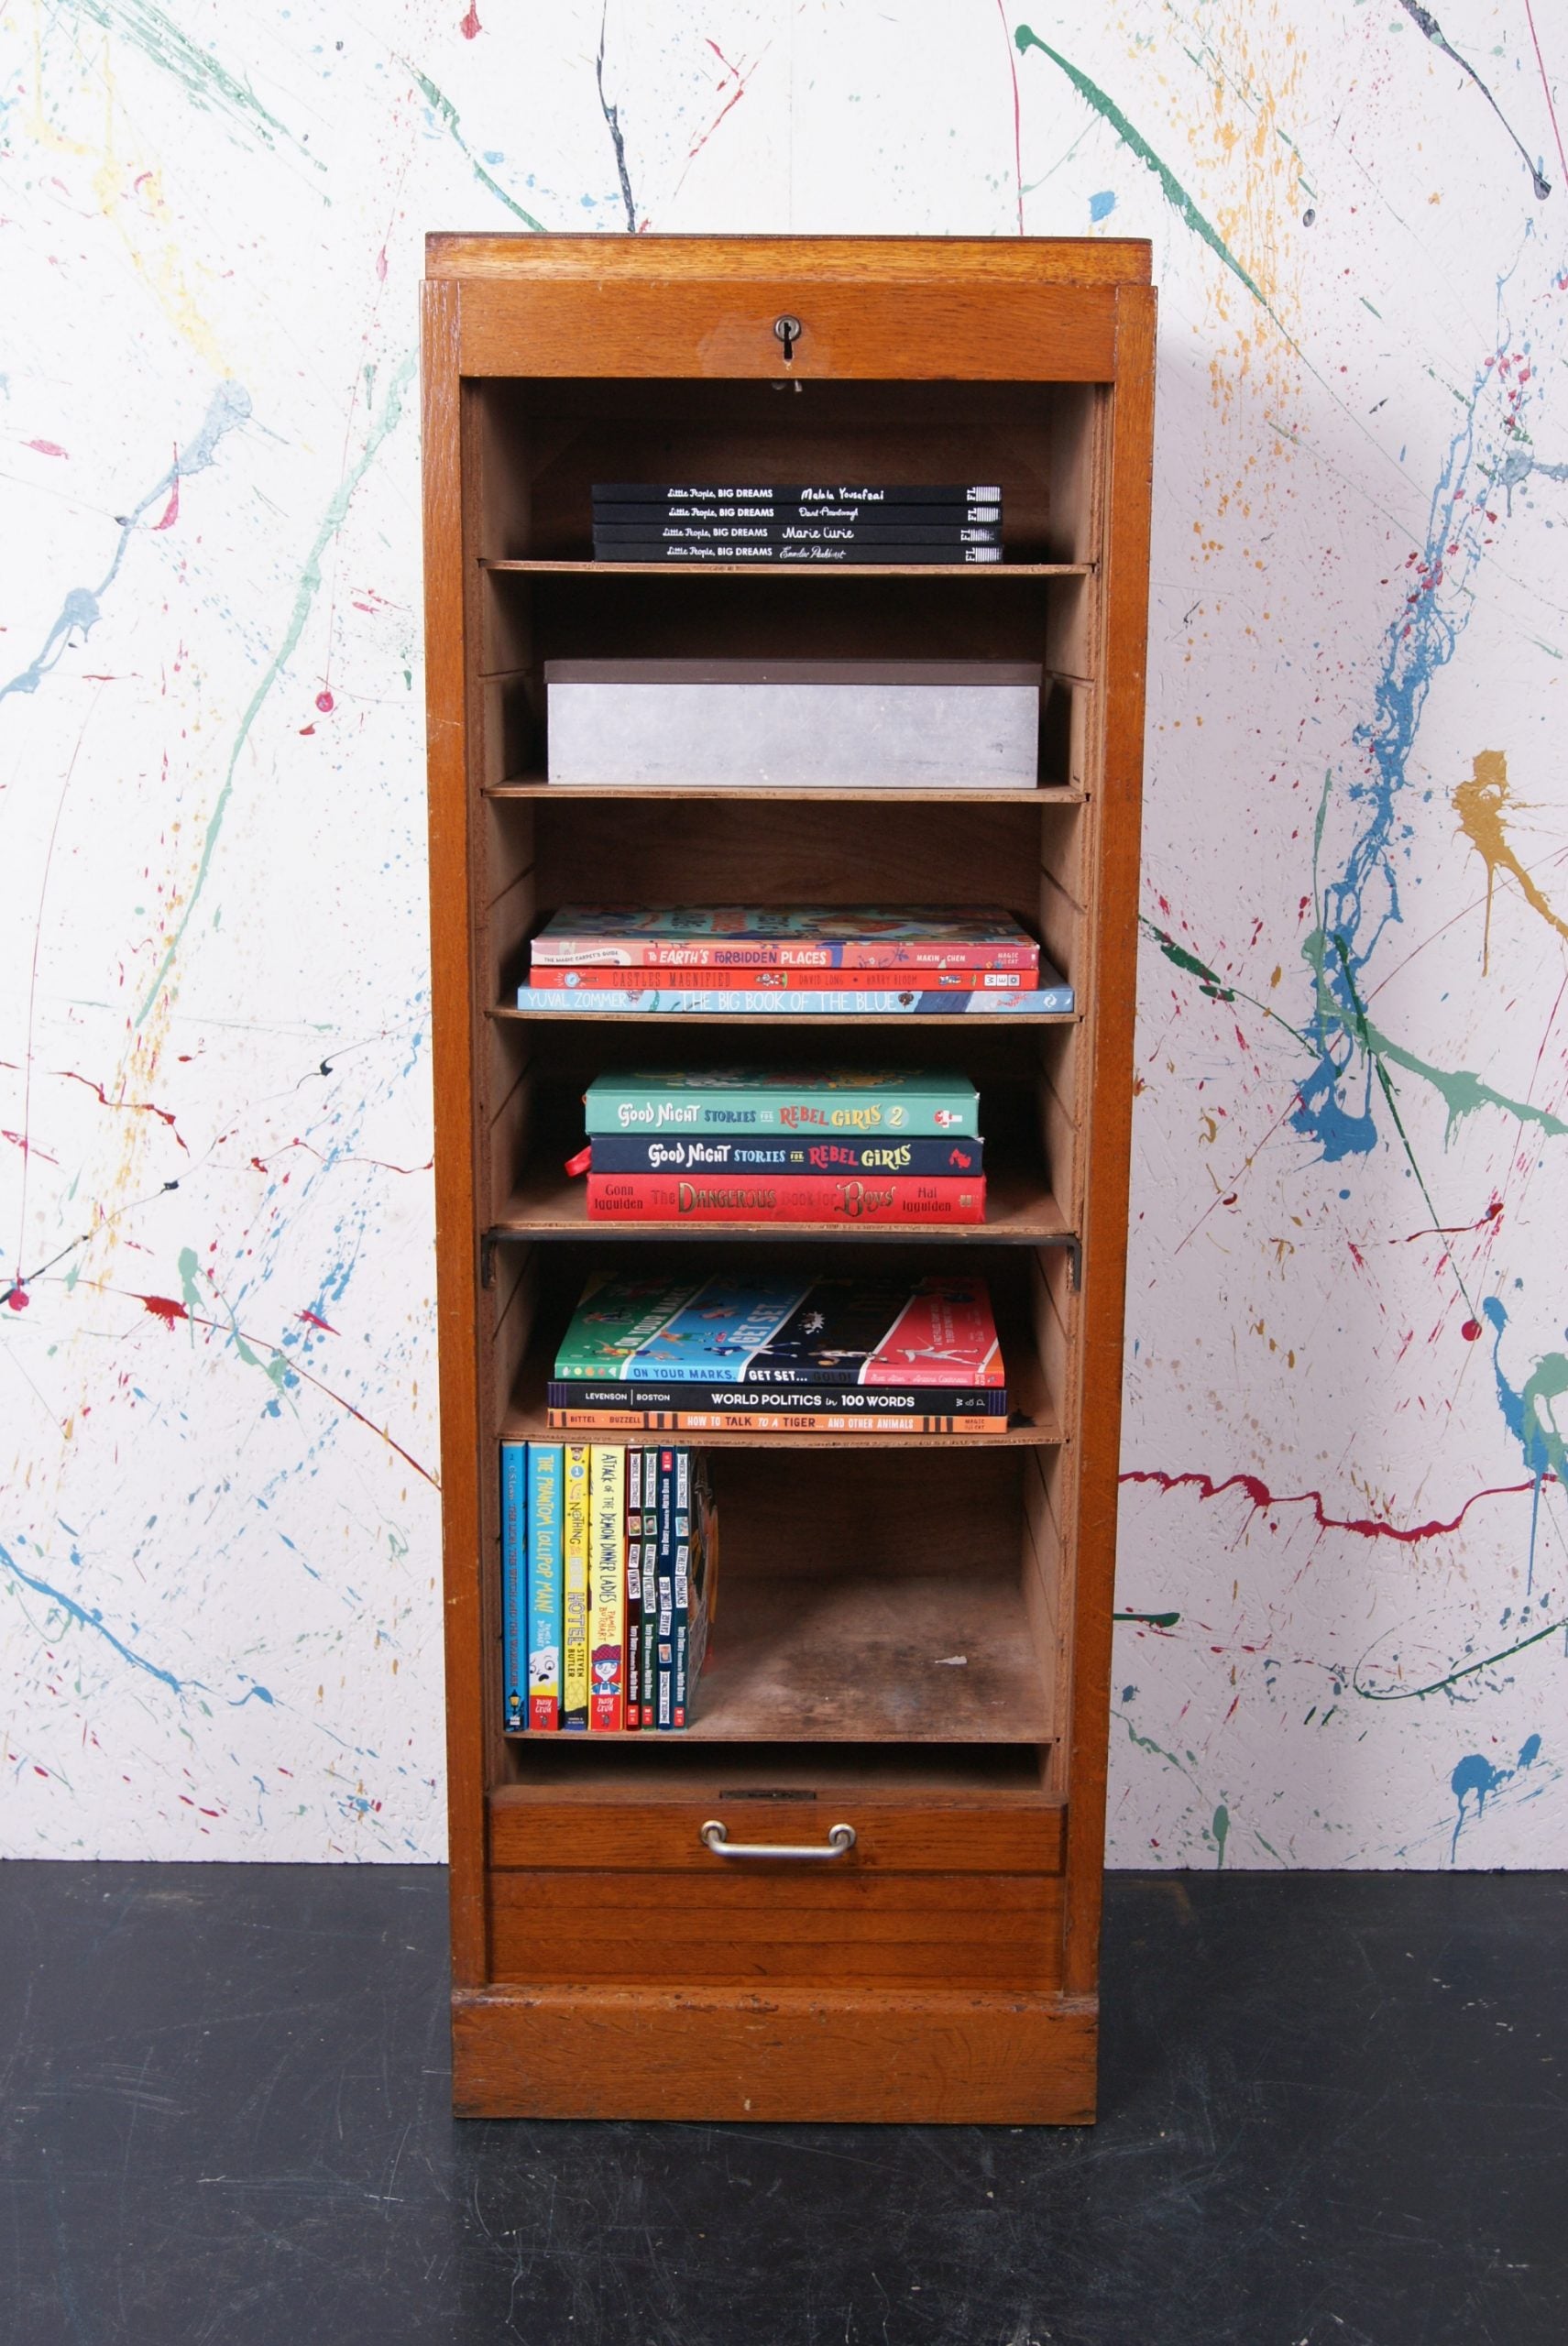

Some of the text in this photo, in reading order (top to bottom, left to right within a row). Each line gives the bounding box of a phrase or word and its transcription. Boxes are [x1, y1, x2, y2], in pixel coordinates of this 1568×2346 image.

[667, 488, 773, 500] Little People, BIG DREAMS
[801, 488, 835, 500] Malala
[669, 508, 774, 520] Little People, BIG DREAMS
[663, 528, 768, 539] Little People, BIG DREAMS
[782, 526, 855, 539] Marie Curie
[667, 547, 773, 558] Little People, BIG DREAMS
[659, 949, 709, 965] EARTH'S
[781, 950, 827, 965] PLACES
[612, 971, 731, 987] CASTLES MAGNIFIED
[799, 974, 820, 985] DAVID
[527, 992, 627, 1007] YUVAL ZOMMER
[680, 992, 895, 1012] THE BIG BOOK OF THE BLUE
[705, 1110, 757, 1123] STORIES
[779, 1105, 829, 1129] REBEL
[889, 1106, 903, 1126] 2
[733, 1150, 786, 1163] STORIES
[790, 1151, 804, 1162] FOR
[808, 1146, 859, 1169] REBEL
[917, 1188, 938, 1199] Hal
[727, 1324, 772, 1343] GET
[632, 1367, 649, 1378] ON
[653, 1368, 685, 1379] YOUR
[749, 1370, 771, 1381] GET
[586, 1392, 671, 1401] LEVENSON BOSTON
[711, 1393, 915, 1408] WORLD POLITICS in 100 WORDS
[609, 1416, 641, 1424] BUZZELL
[687, 1416, 707, 1426] HOW
[711, 1416, 721, 1426] TO
[725, 1416, 751, 1427] TALK
[757, 1417, 768, 1427] TO
[772, 1417, 778, 1427] A
[828, 1418, 845, 1429] AND
[849, 1418, 873, 1429] OTHER
[877, 1418, 914, 1430] ANIMALS
[601, 1453, 618, 1483] ATTACK
[603, 1496, 615, 1508] THE
[569, 1502, 585, 1544] NOTHING
[599, 1512, 617, 1540] DEMON
[533, 1454, 554, 1613] THE PHANTOM LOLLIPOP MAN!
[599, 1543, 617, 1572] DINNER
[630, 1570, 640, 1595] VIKINGS
[676, 1547, 686, 1604] RUTHLESS ROMANS
[599, 1575, 617, 1603] LADIES
[660, 1582, 670, 1592] AGE
[567, 1592, 586, 1647] HOTEL
[598, 1606, 608, 1641] BUTCHART
[608, 1610, 616, 1637] PAMELA
[567, 1649, 576, 1678] BUTLER
[576, 1649, 585, 1678] STEVEN
